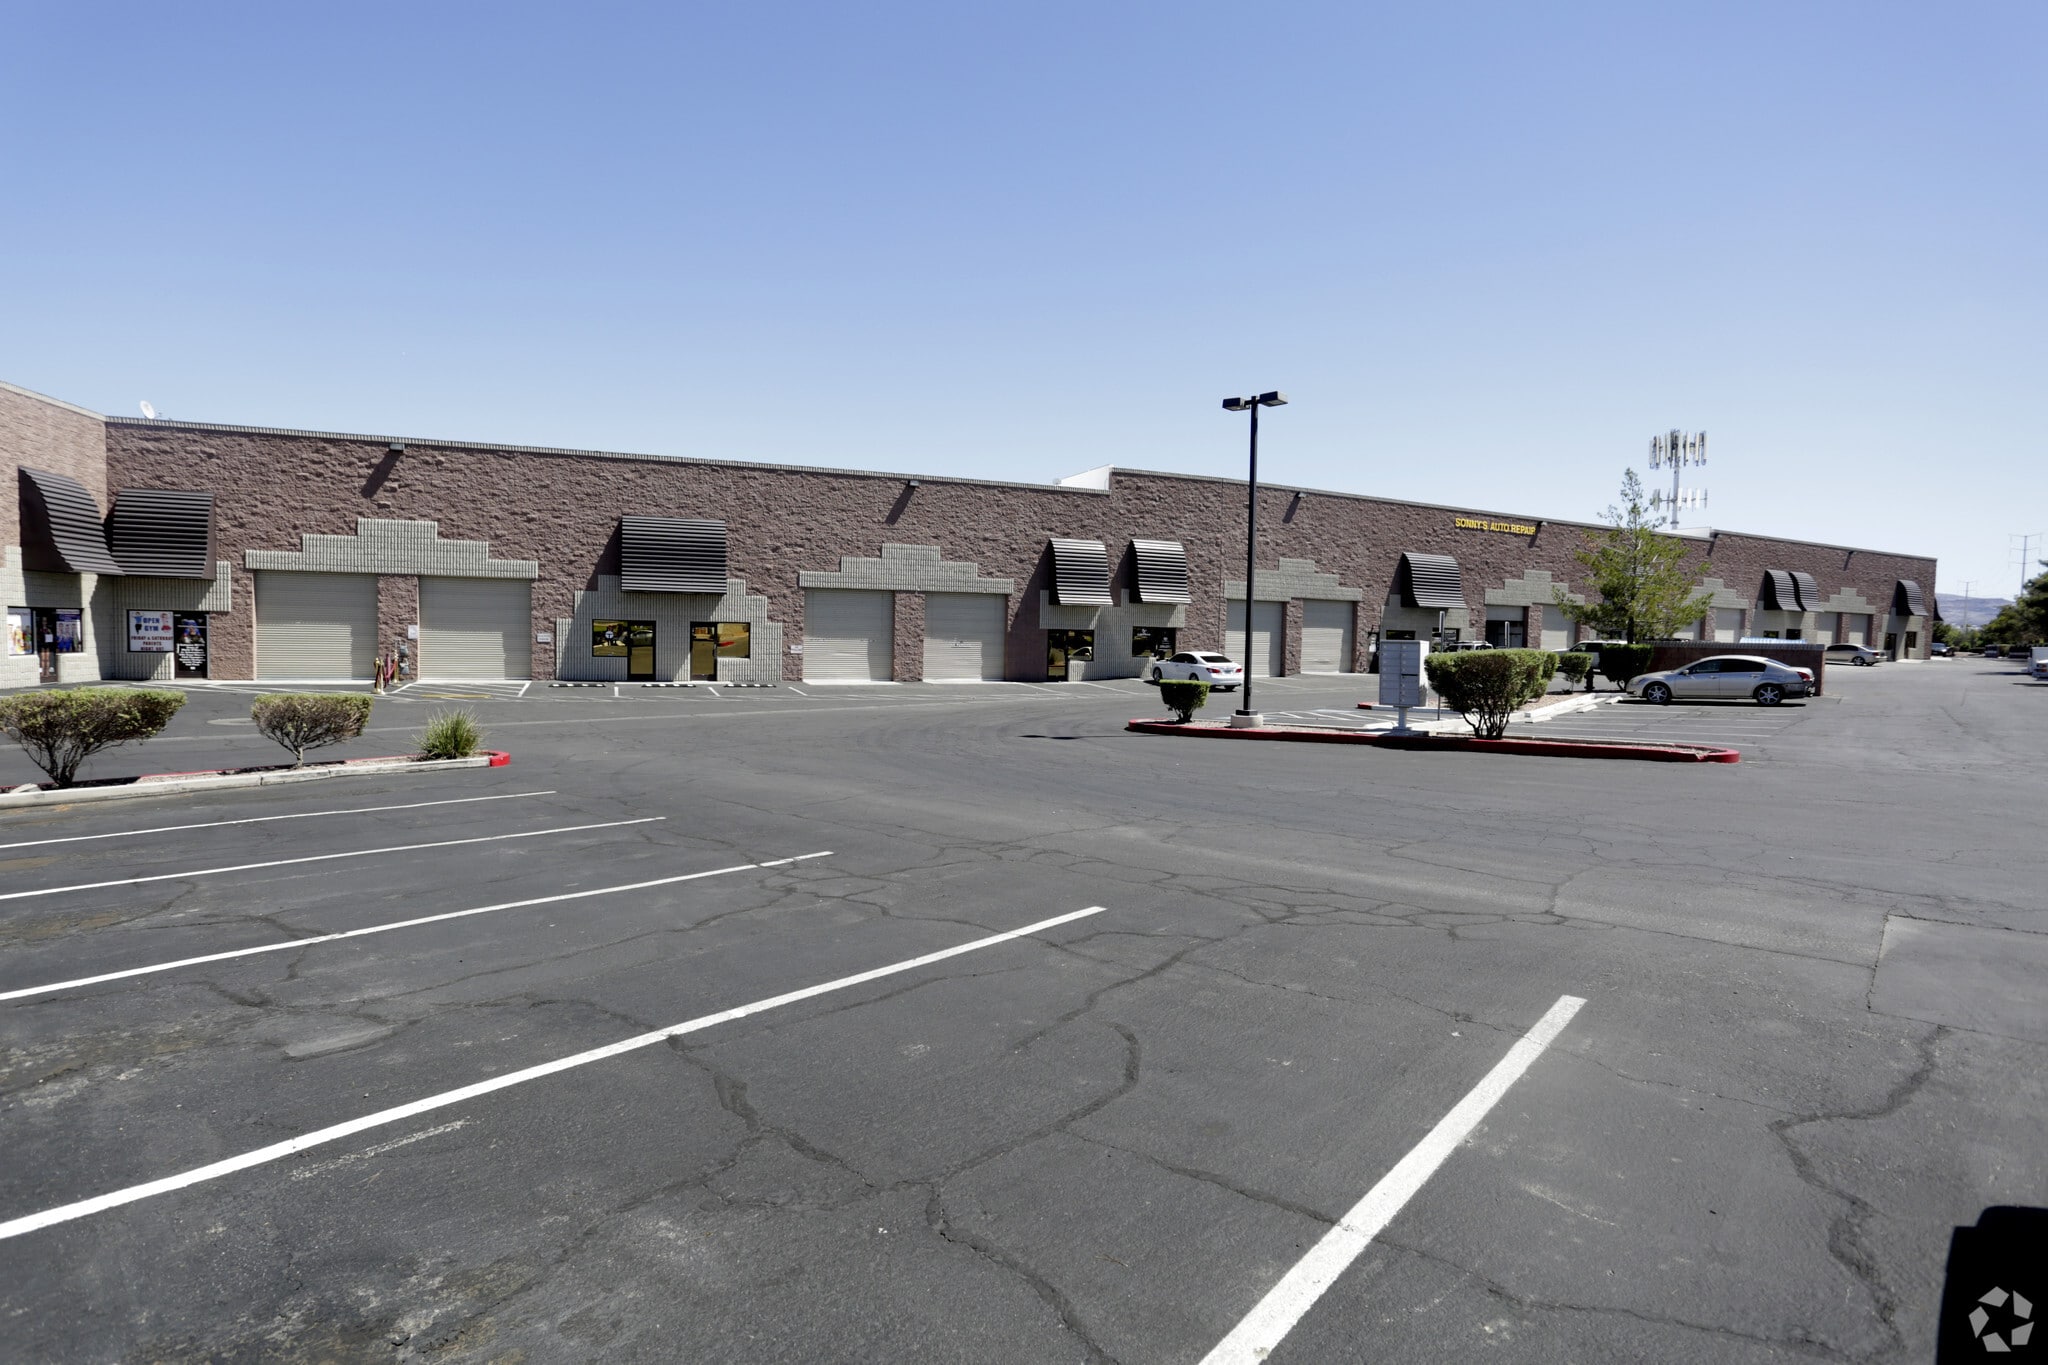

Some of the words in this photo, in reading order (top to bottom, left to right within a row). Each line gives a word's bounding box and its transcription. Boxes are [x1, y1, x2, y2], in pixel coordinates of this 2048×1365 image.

[1455, 518, 1488, 530] SONNY'S
[1490, 522, 1510, 532] AUTO
[1511, 524, 1536, 535] REPAIR
